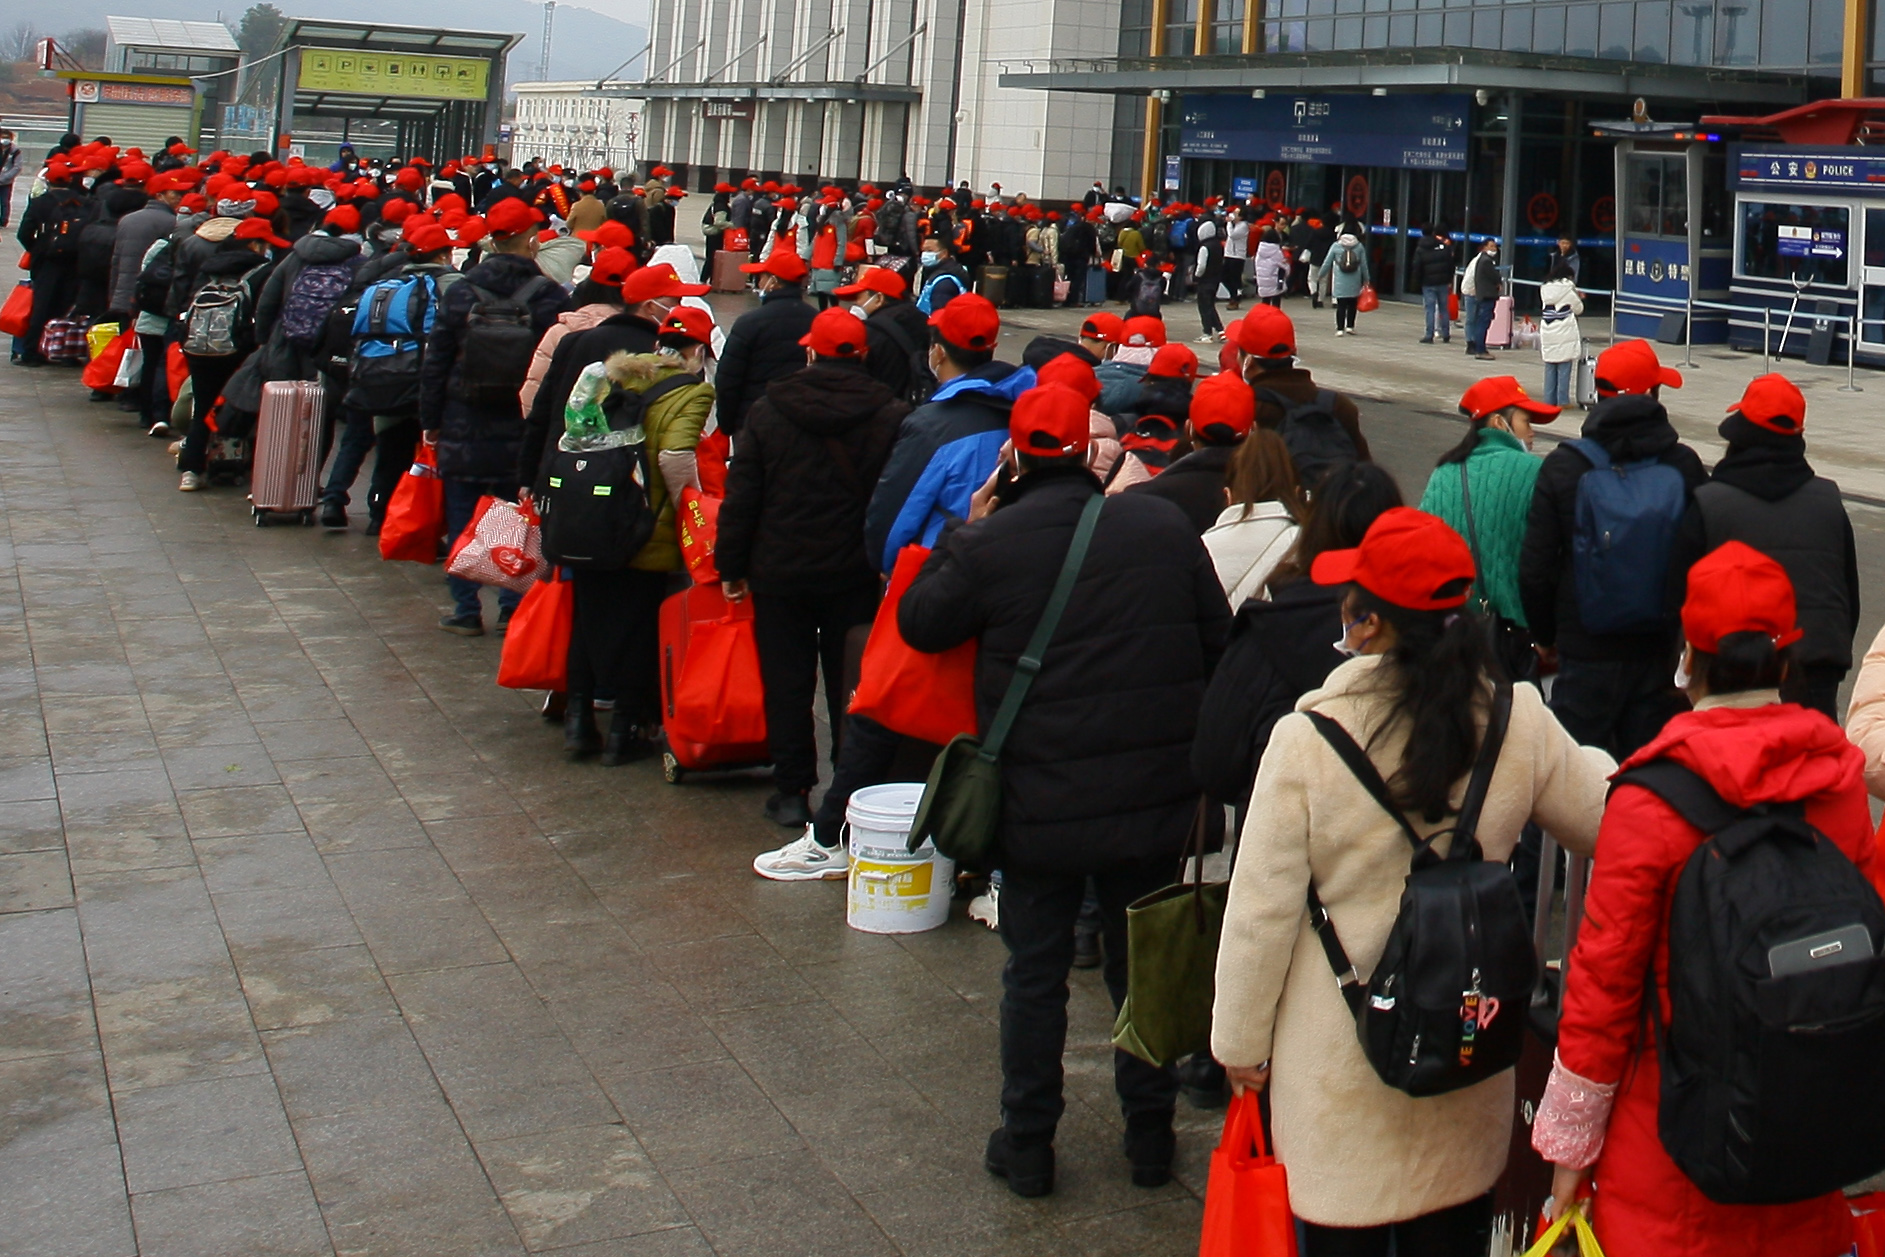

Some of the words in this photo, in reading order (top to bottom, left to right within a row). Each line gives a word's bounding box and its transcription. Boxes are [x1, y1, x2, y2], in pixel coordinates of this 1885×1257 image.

[1770, 161, 1799, 177] 公安
[1822, 164, 1854, 177] POLICE
[1462, 997, 1478, 1041] LOVE
